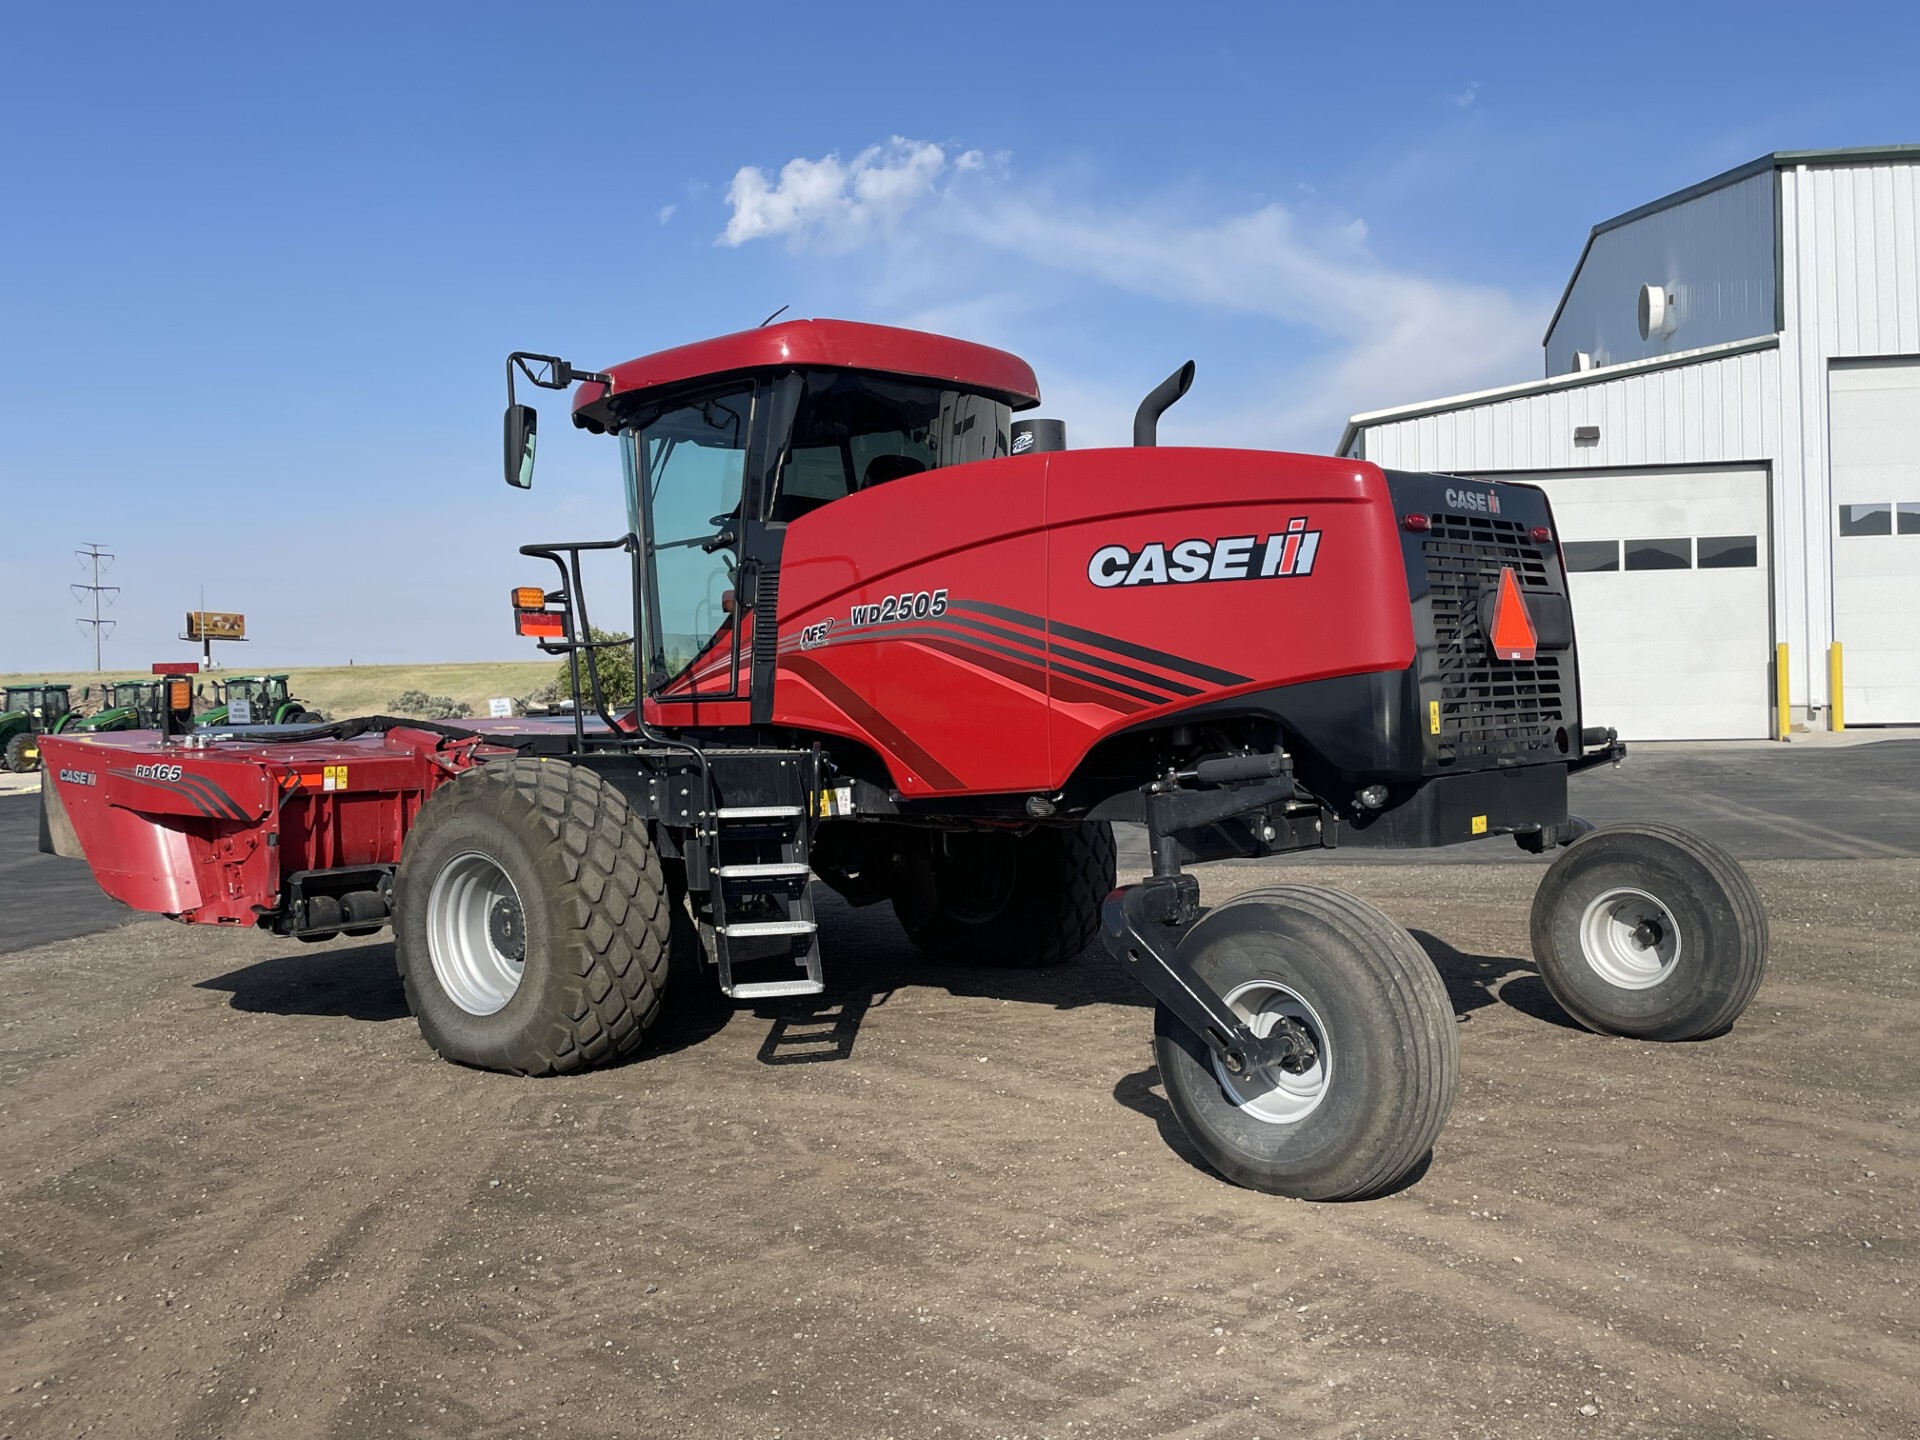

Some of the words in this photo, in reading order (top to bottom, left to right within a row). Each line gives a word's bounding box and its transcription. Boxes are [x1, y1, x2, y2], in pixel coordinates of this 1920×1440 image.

[1445, 488, 1487, 512] CASE
[1088, 537, 1256, 587] CASE
[851, 588, 949, 626] WD2505
[800, 622, 828, 644] AFS
[60, 768, 88, 785] CASE
[135, 763, 183, 782] RD165
